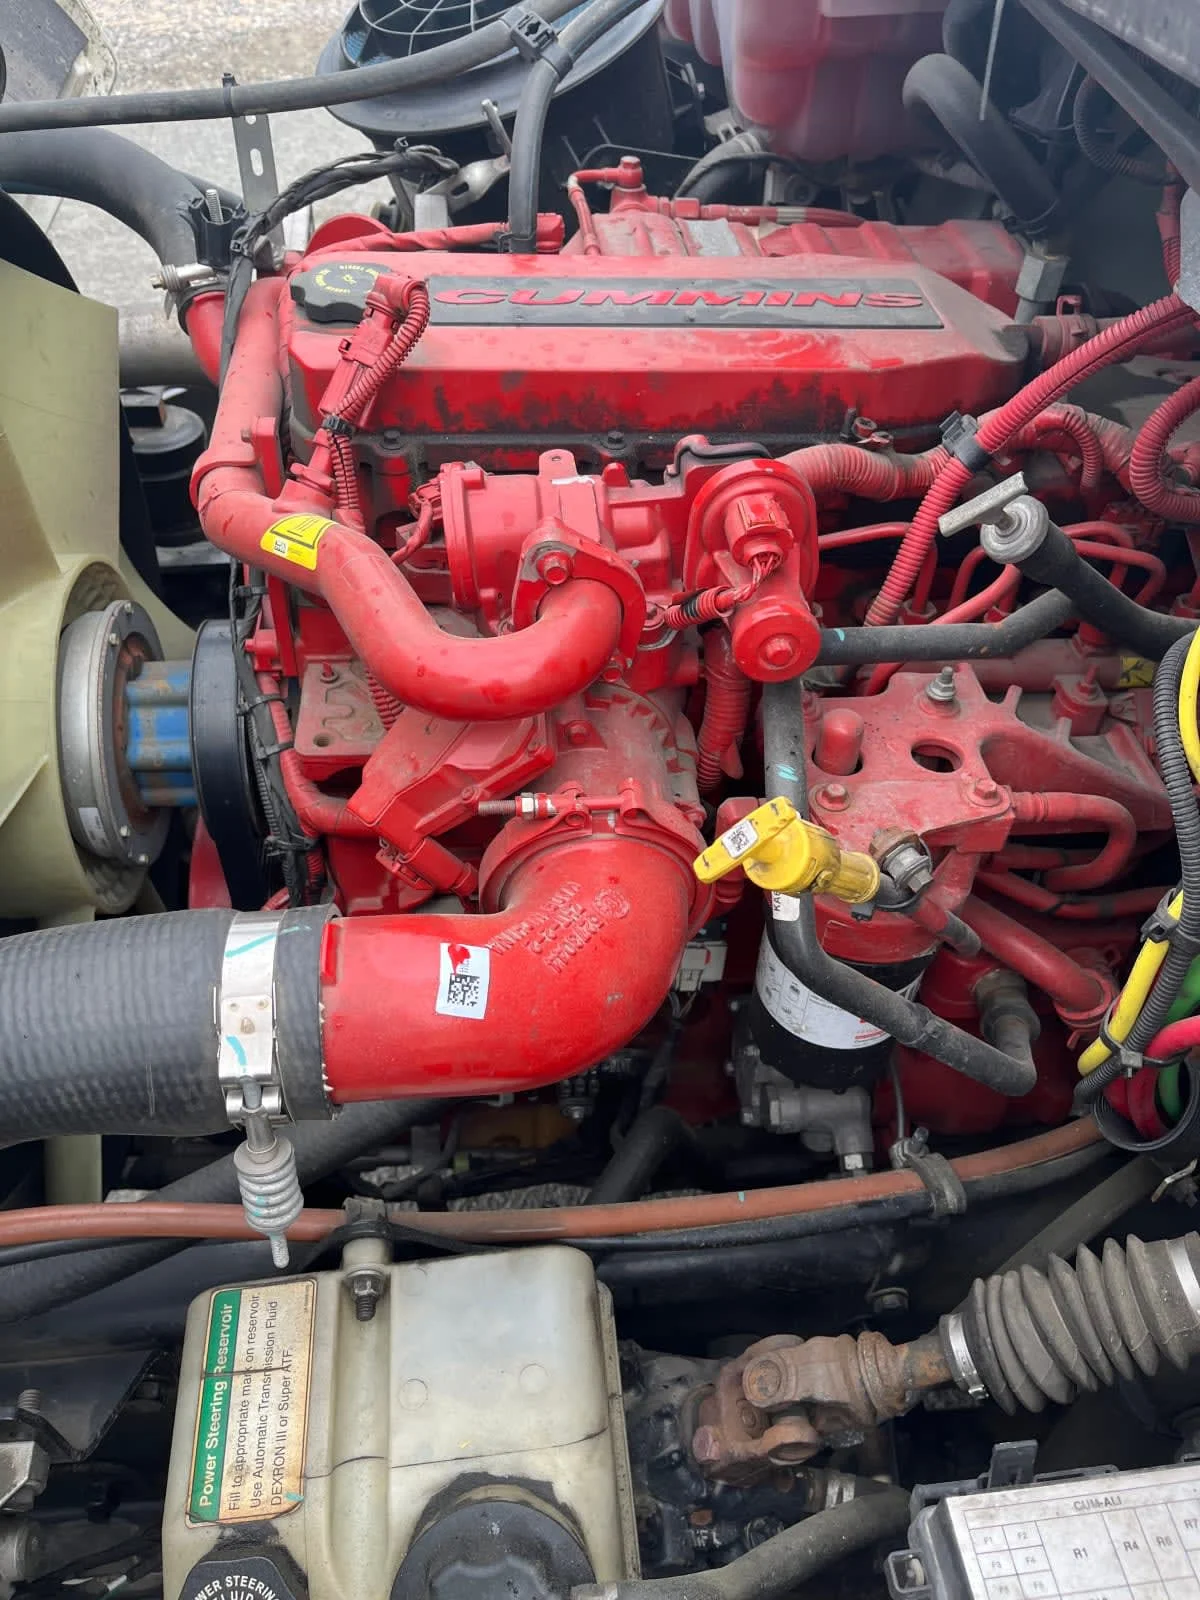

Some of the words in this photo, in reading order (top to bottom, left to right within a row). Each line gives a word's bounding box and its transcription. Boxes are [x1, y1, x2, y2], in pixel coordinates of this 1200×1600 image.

[433, 288, 925, 308] CUMMINS
[266, 1301, 278, 1329] Fluid
[214, 1303, 233, 1377] Reservoir
[246, 1348, 254, 1362] on
[242, 1366, 252, 1397] mark
[258, 1331, 276, 1413] Transmission
[278, 1375, 292, 1411] Super
[205, 1380, 228, 1449] Steering
[279, 1414, 288, 1427] or
[235, 1400, 250, 1471] appropriate
[253, 1415, 268, 1478] Automatic
[275, 1430, 287, 1443] III
[199, 1453, 217, 1507] Power
[232, 1475, 242, 1489] to
[271, 1446, 286, 1506] DEXRON
[228, 1492, 241, 1511] Fill
[250, 1481, 262, 1508] Use
[1183, 1518, 1198, 1529] R7
[1073, 1547, 1089, 1560] R1
[1123, 1541, 1140, 1552] R4
[195, 1579, 223, 1600] WER
[225, 1575, 280, 1600] STEERIN
